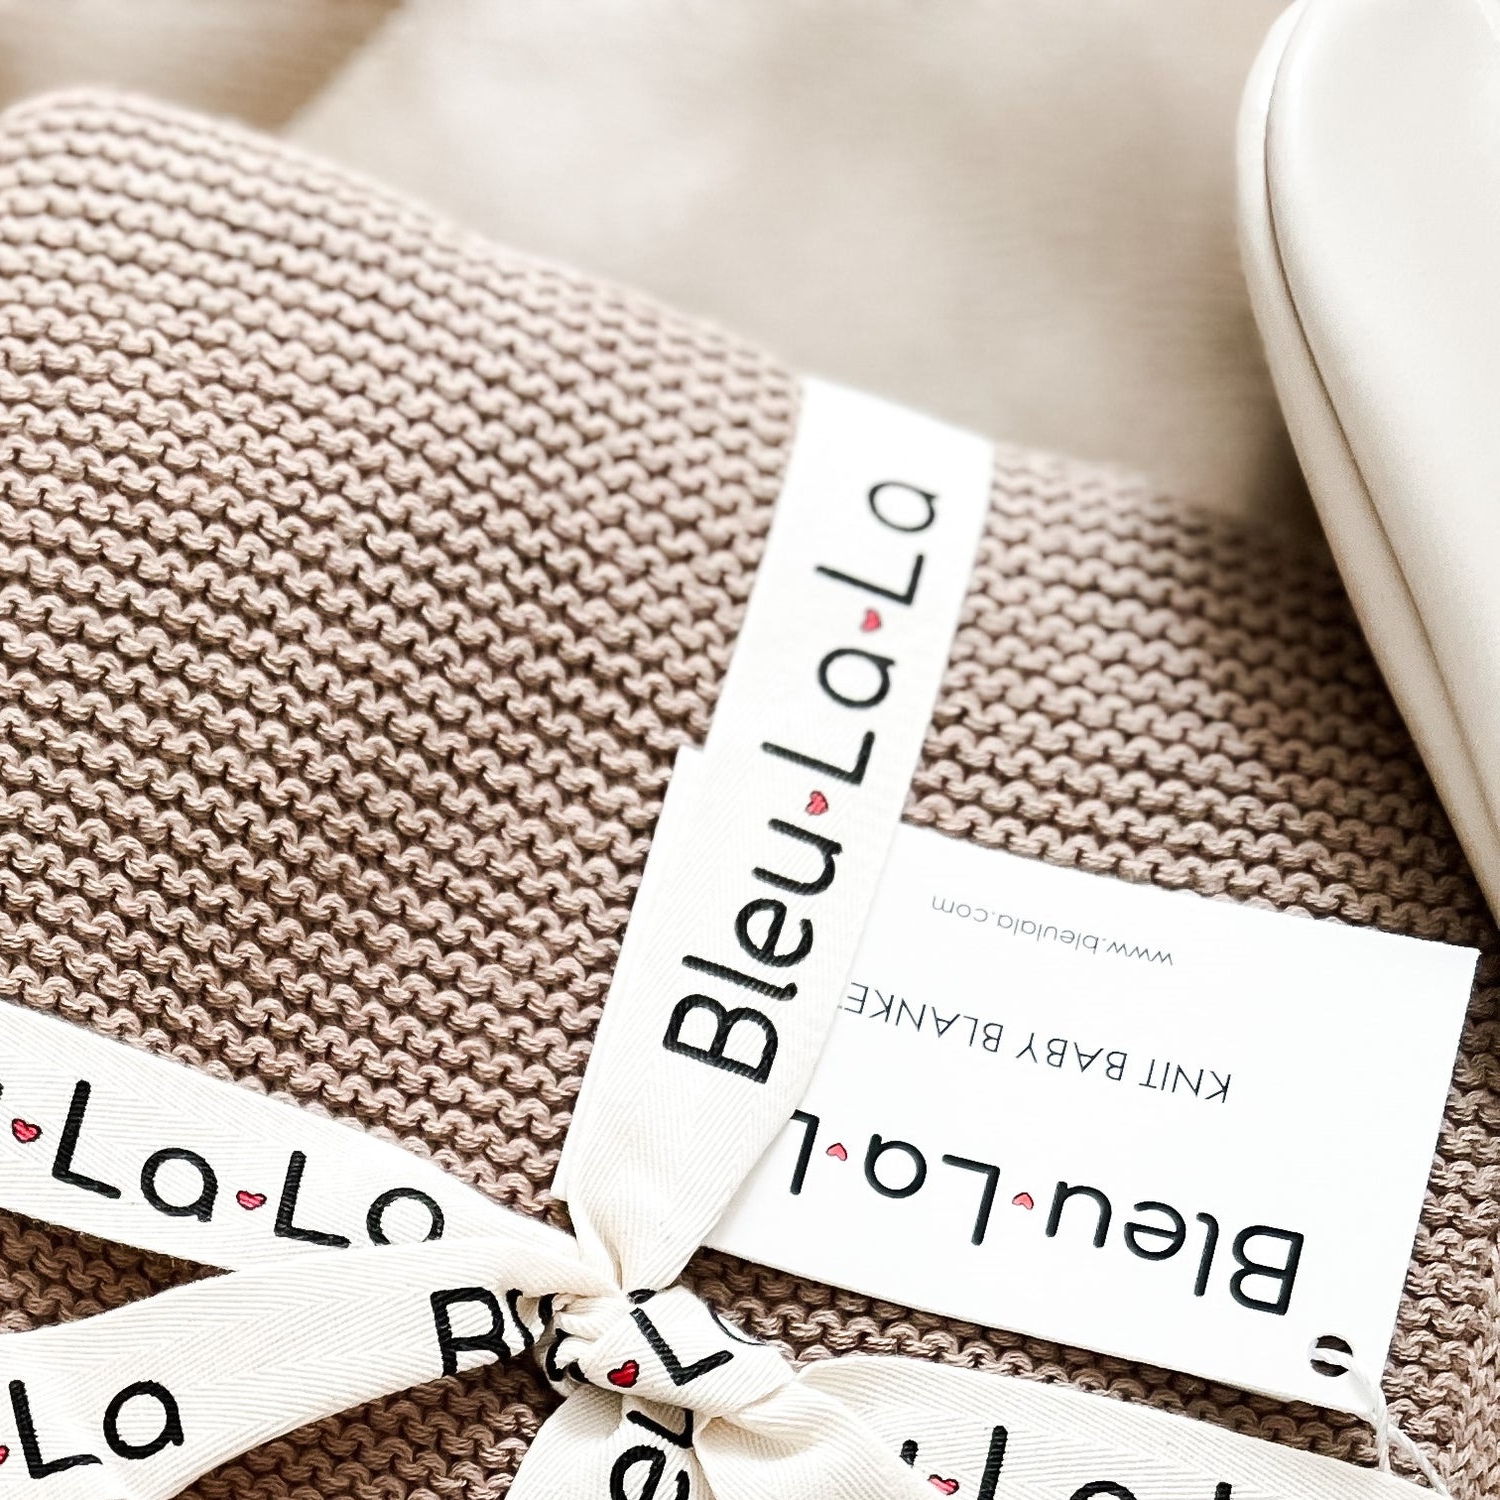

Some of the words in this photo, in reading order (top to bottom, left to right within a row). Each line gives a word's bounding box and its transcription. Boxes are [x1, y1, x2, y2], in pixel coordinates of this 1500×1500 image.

[815, 481, 938, 606] La
[761, 648, 895, 786] La
[662, 818, 843, 1085] Bleu
[931, 895, 1174, 967] www.bleulala.com
[836, 981, 1004, 1054] BLANKE
[1015, 1032, 1128, 1082] BABY
[1138, 1058, 1232, 1104] KNIT
[51, 1079, 219, 1223] La
[864, 1133, 1001, 1246] La
[1045, 1181, 1305, 1317] Bleu
[8, 1379, 185, 1480] La
